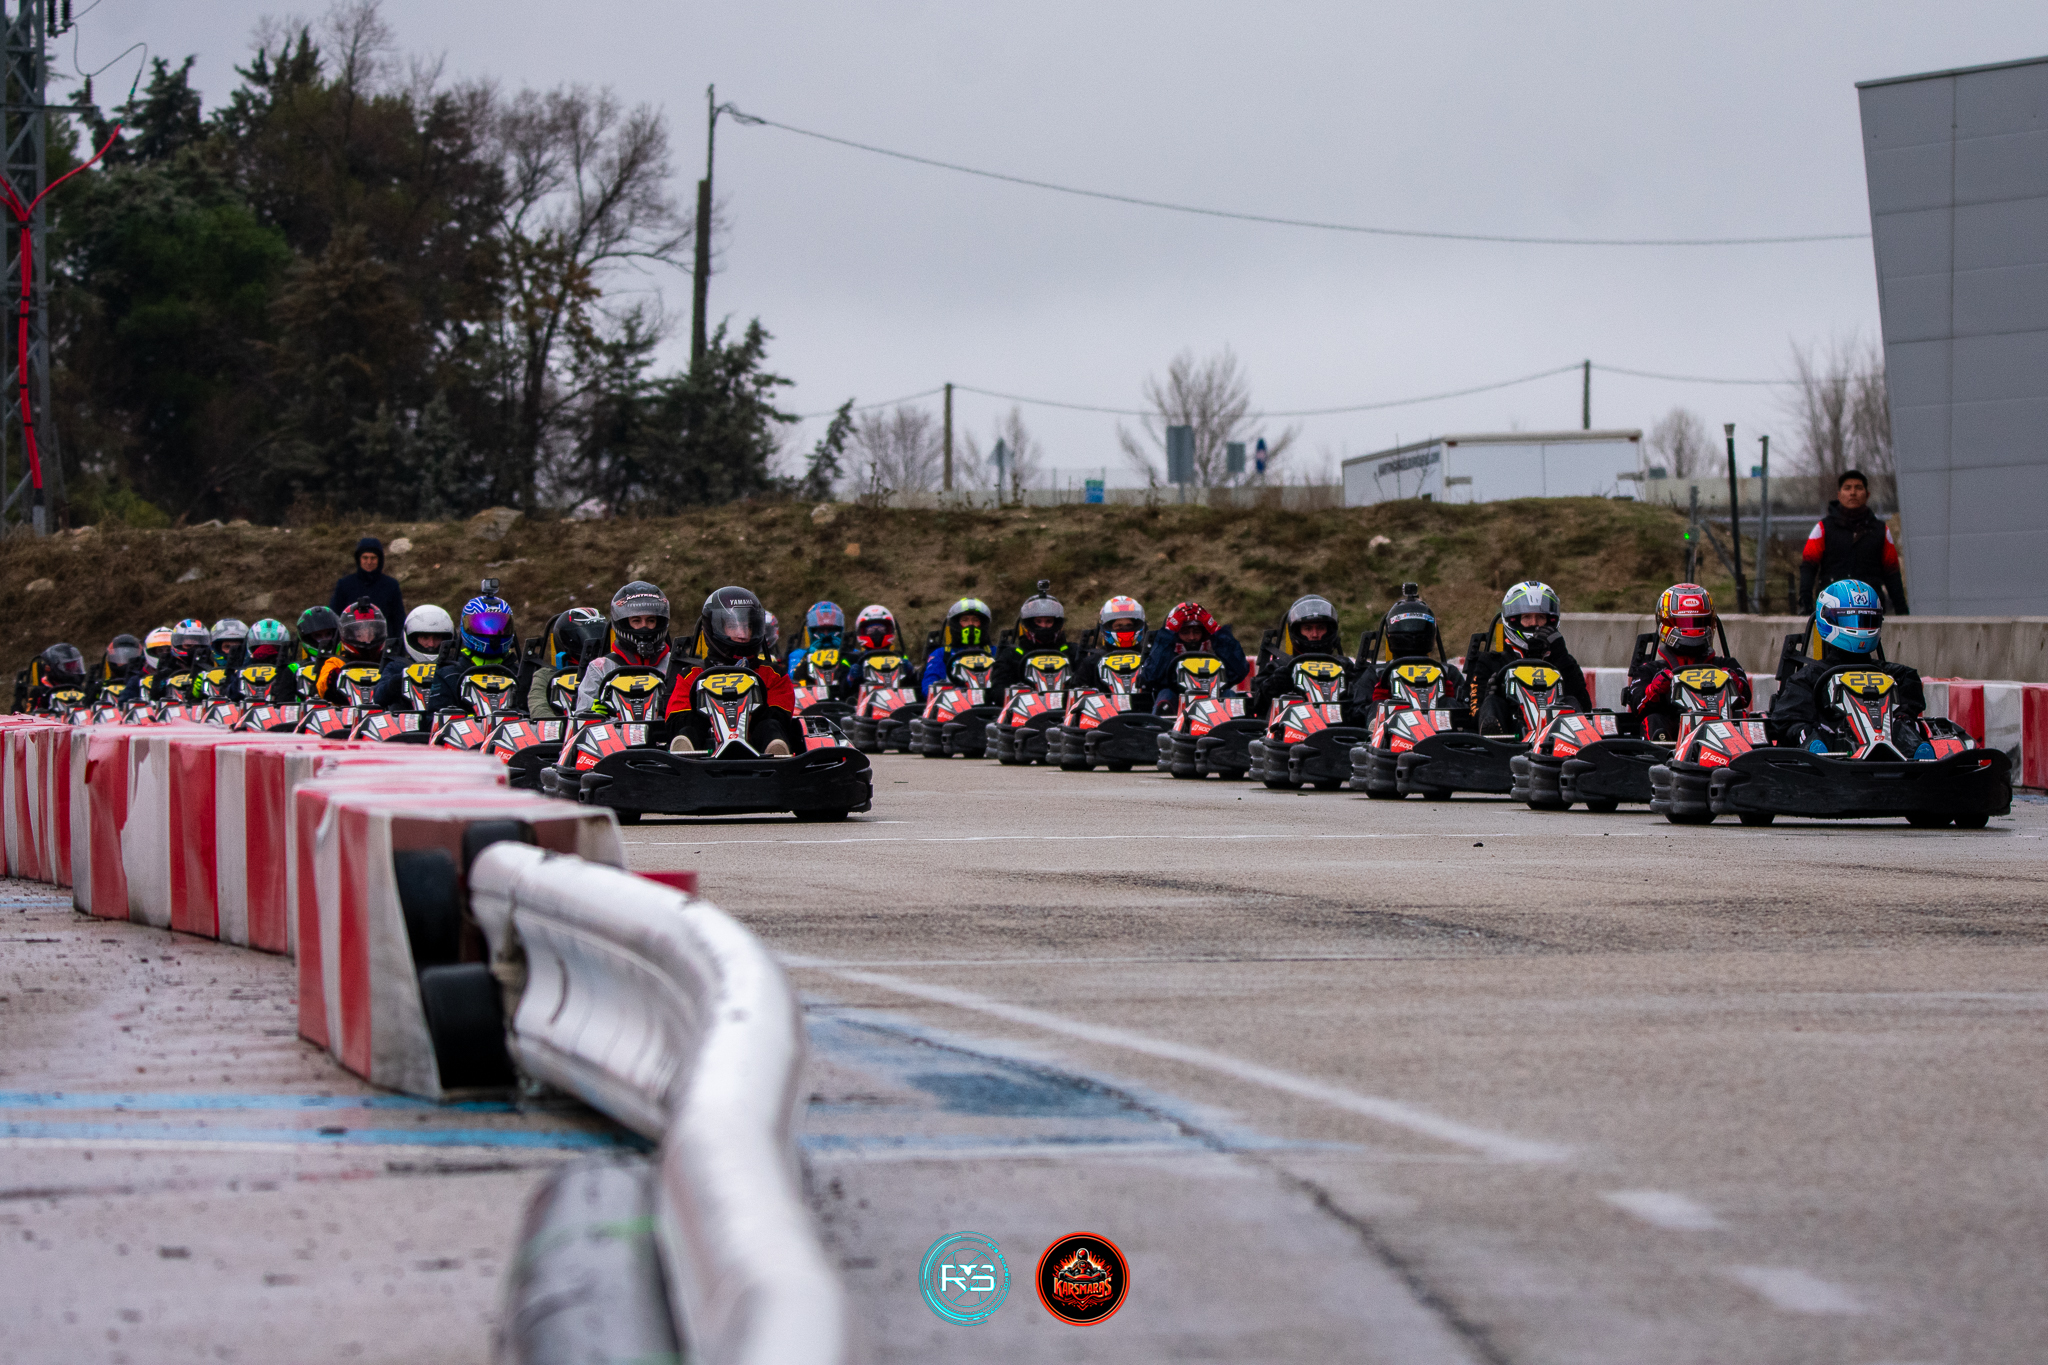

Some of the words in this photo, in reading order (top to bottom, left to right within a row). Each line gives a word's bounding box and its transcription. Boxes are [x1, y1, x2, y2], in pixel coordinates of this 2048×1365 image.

[816, 650, 835, 662] 14
[965, 656, 988, 665] 20
[1037, 657, 1060, 666] 25
[1111, 655, 1135, 666] 23
[250, 666, 272, 678] 12
[1307, 662, 1334, 673] 22
[1407, 666, 1433, 678] 17
[365, 669, 378, 679] 5
[1531, 668, 1547, 681] 4
[1686, 669, 1718, 682] 24
[1849, 673, 1885, 686] 26
[633, 676, 650, 686] 2
[711, 674, 744, 689] 27
[1708, 754, 1729, 766] SODI
